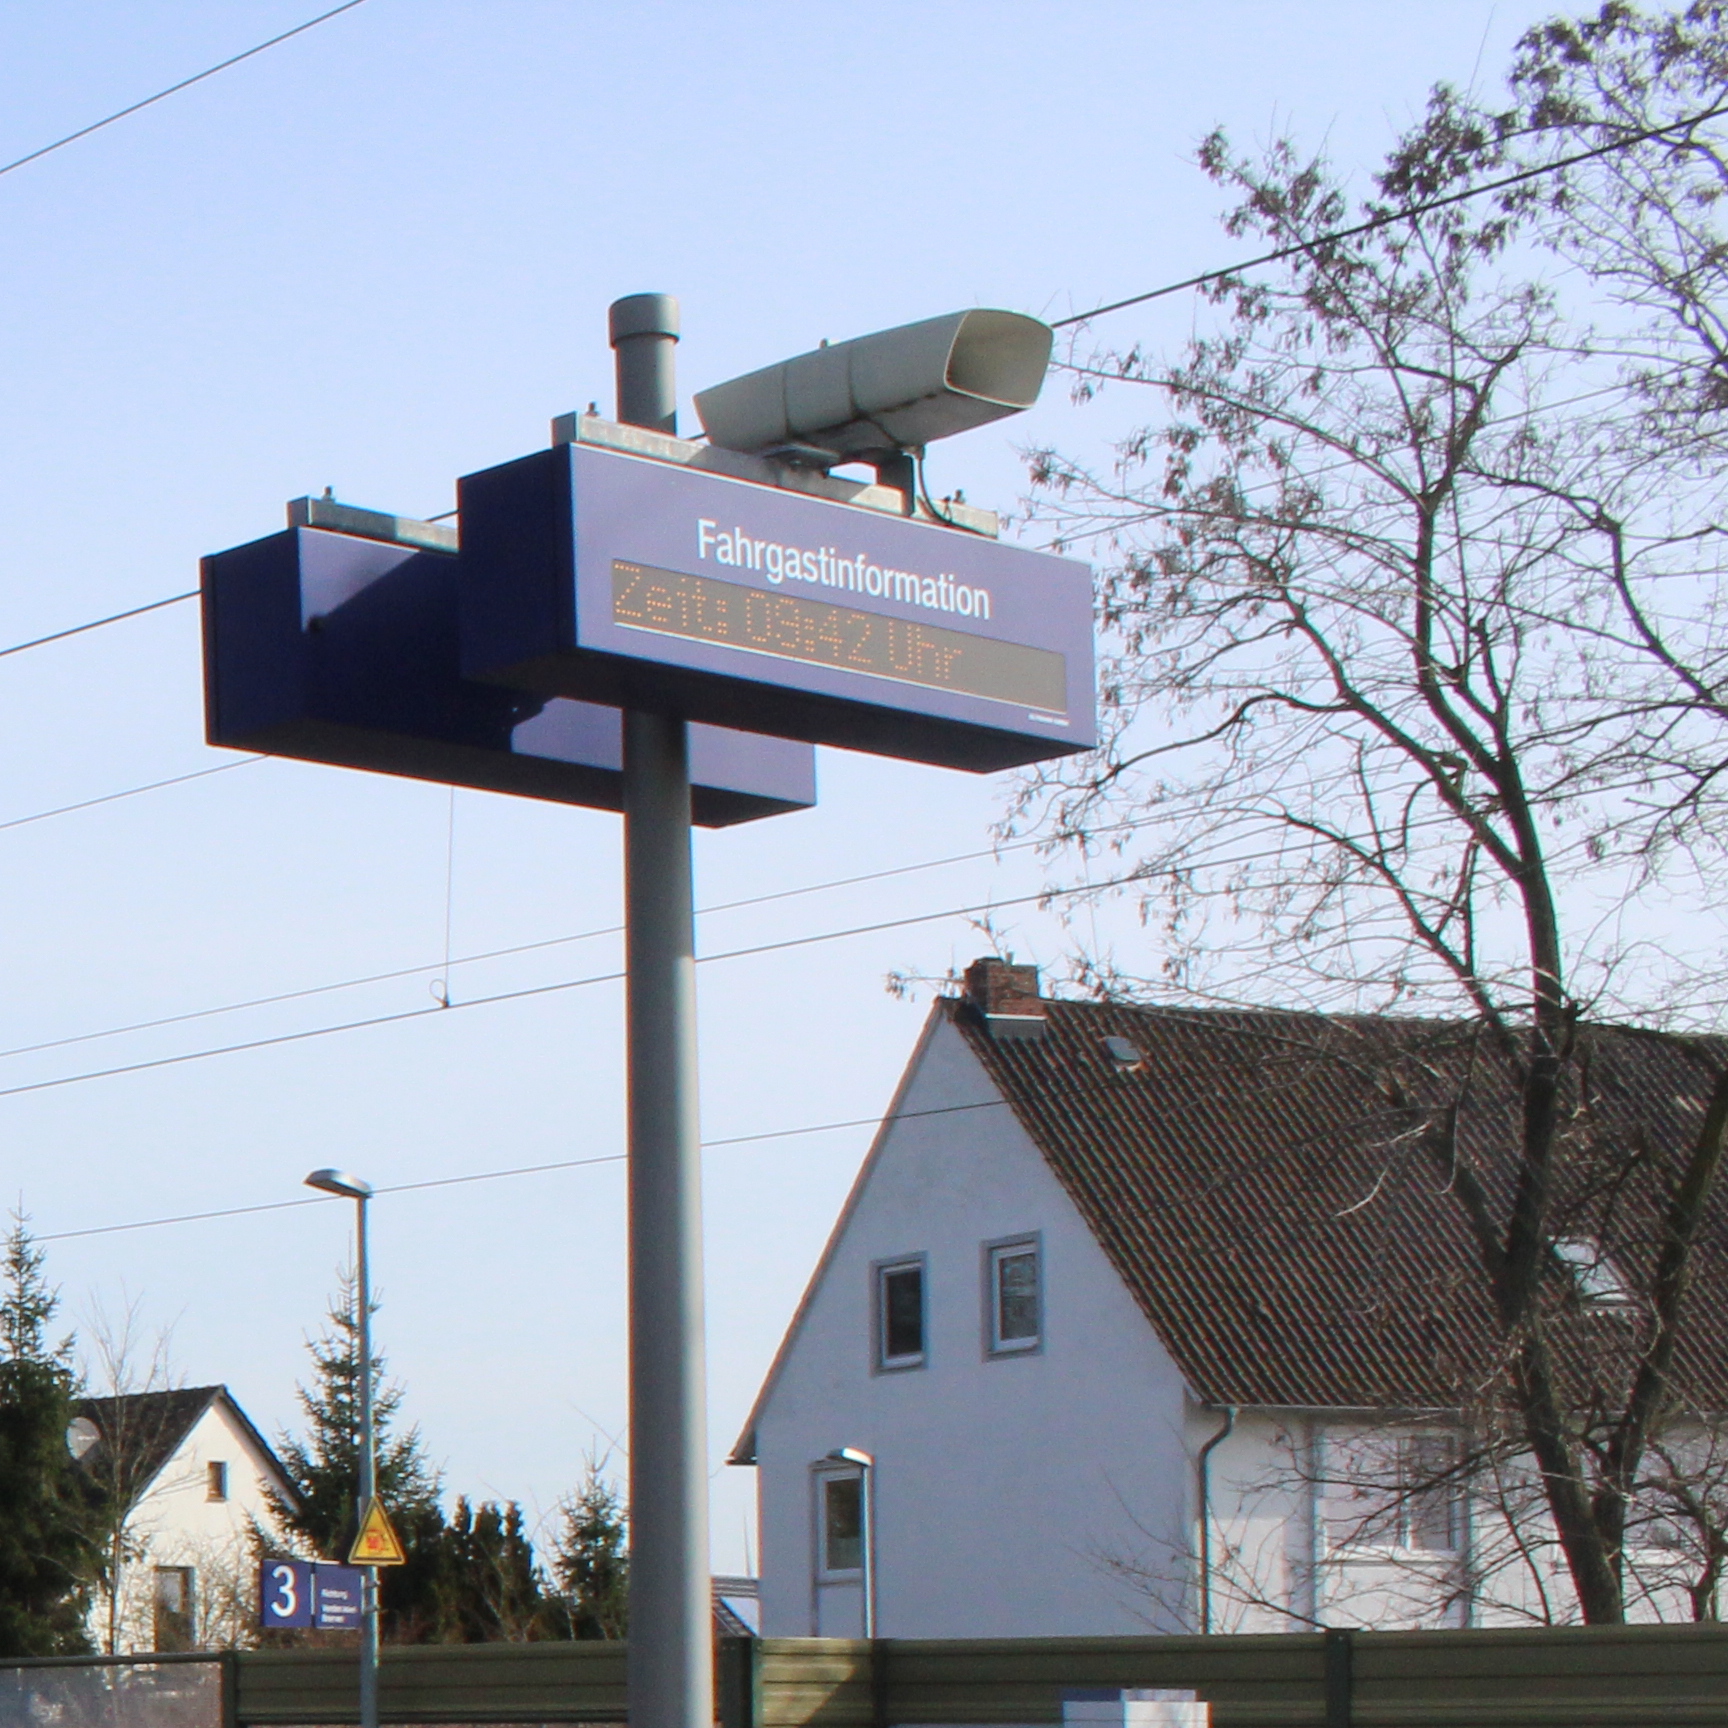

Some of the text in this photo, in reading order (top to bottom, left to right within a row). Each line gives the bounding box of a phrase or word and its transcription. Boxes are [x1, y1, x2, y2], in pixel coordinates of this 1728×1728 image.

[696, 518, 991, 620] Fahrgastinformation
[613, 562, 964, 681] Zeit: 09:42 Uhr
[271, 1565, 297, 1617] 3
